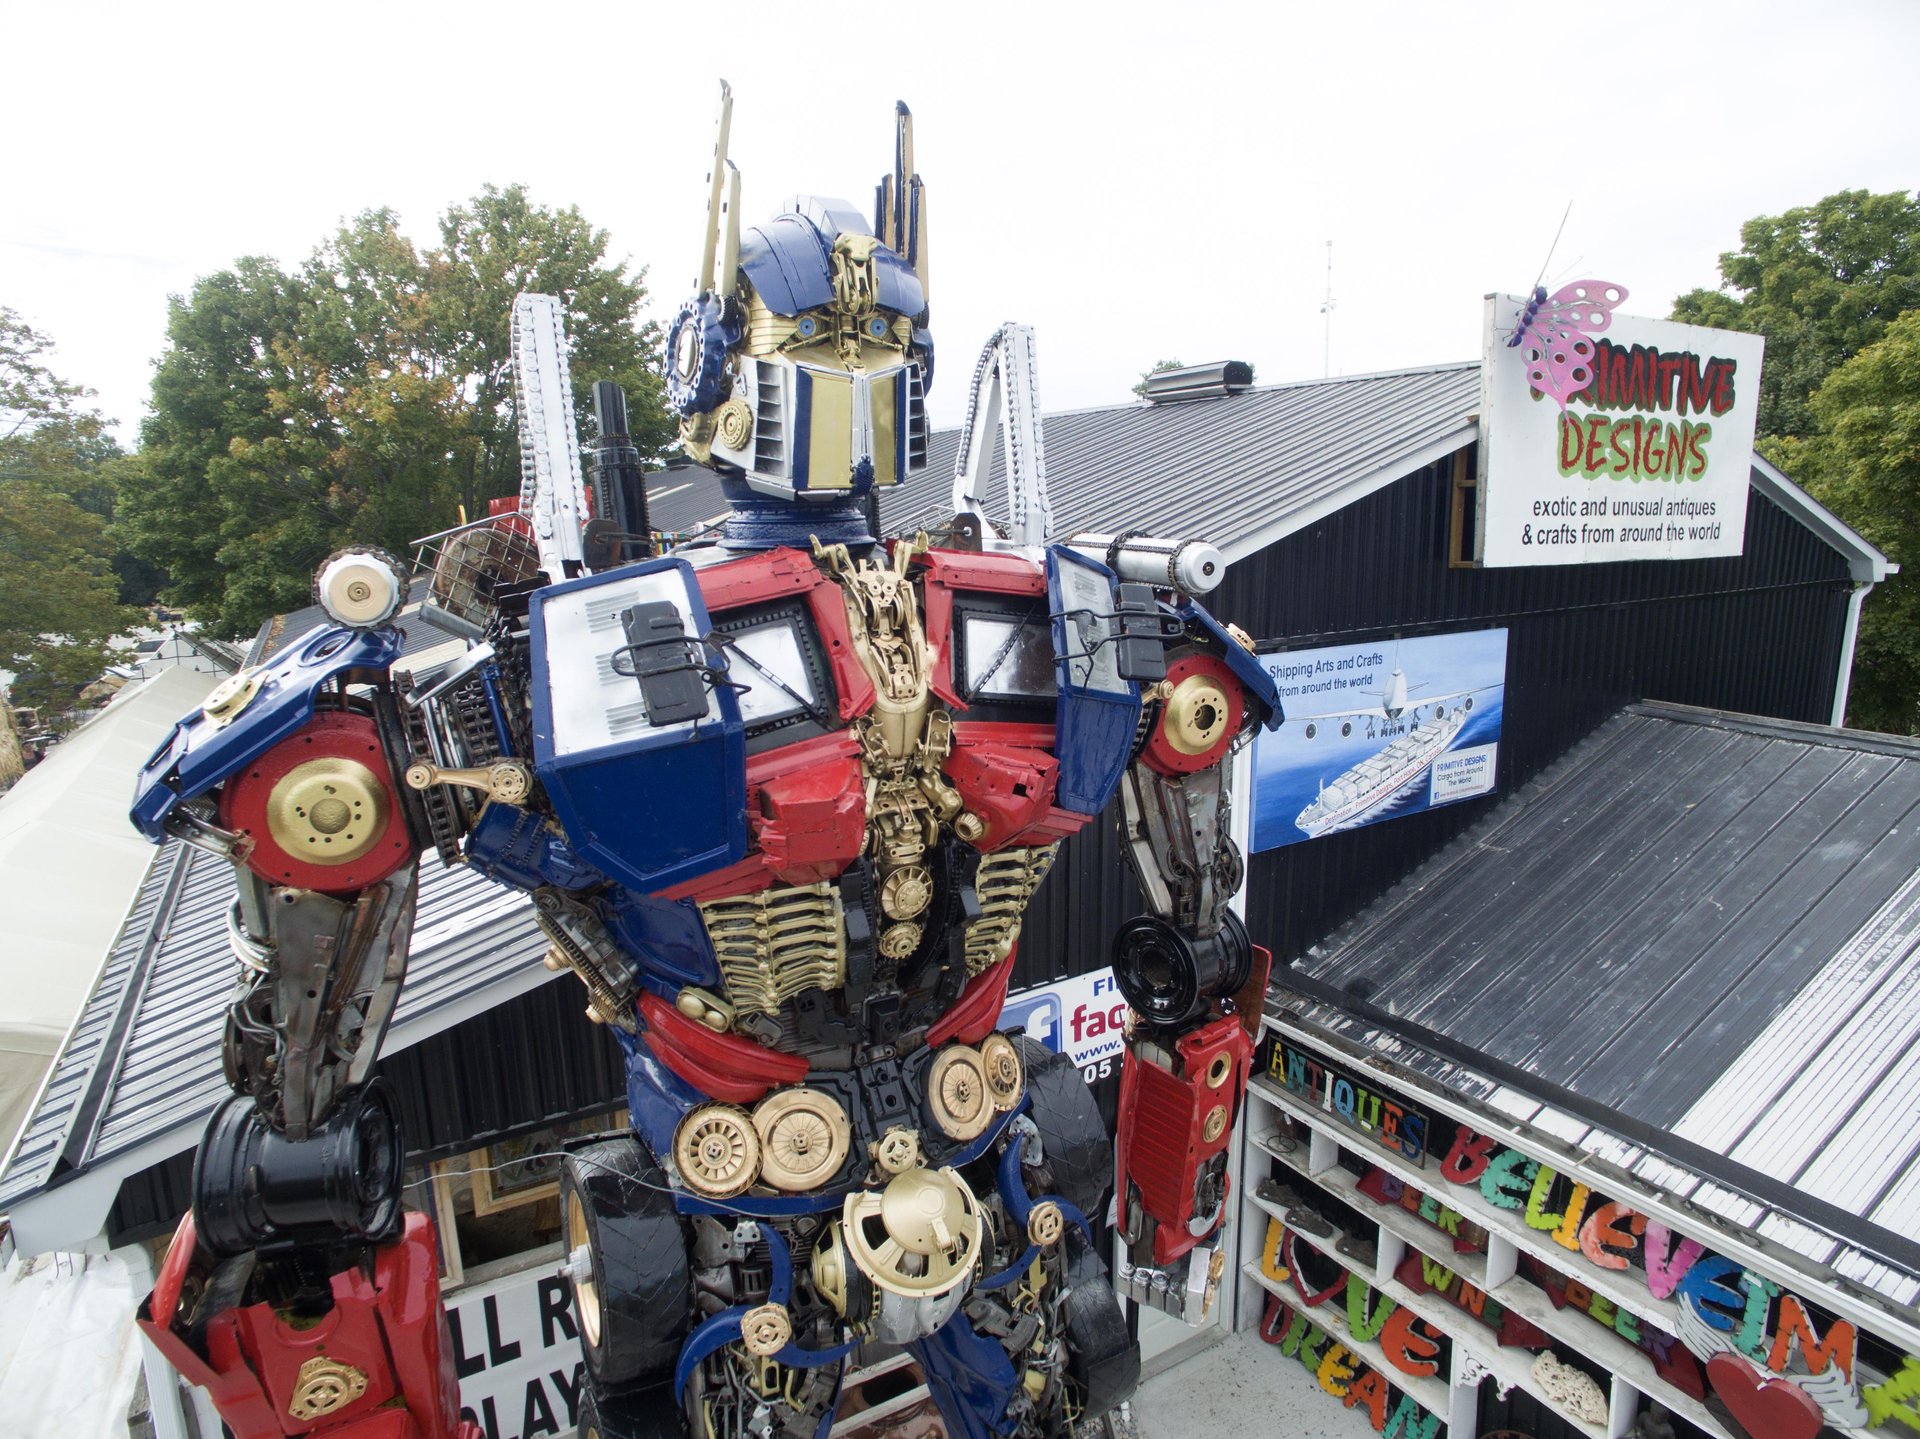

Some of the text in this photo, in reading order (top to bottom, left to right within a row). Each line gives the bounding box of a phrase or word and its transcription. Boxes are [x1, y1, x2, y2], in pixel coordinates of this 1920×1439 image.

[1530, 338, 1737, 416] IMITIVE
[1560, 414, 1710, 478] DESIGNS
[1533, 496, 1716, 520] exotic and unusual antiques
[1521, 521, 1721, 545] & crafts from around the world
[1269, 652, 1383, 680] Shipping Arts and Crafts
[1278, 673, 1373, 698] from around the world
[1437, 754, 1486, 772] PRIMITIVE DESIGNS
[1437, 772, 1453, 782] Cargo
[1466, 766, 1483, 775] Around
[1355, 794, 1376, 809] Primitive
[1094, 976, 1119, 996] FI
[1070, 1003, 1130, 1043] fac
[1075, 1040, 1121, 1062] www.
[1270, 1041, 1424, 1160] ANTIQUES
[1440, 1124, 1747, 1333] BELIEVE
